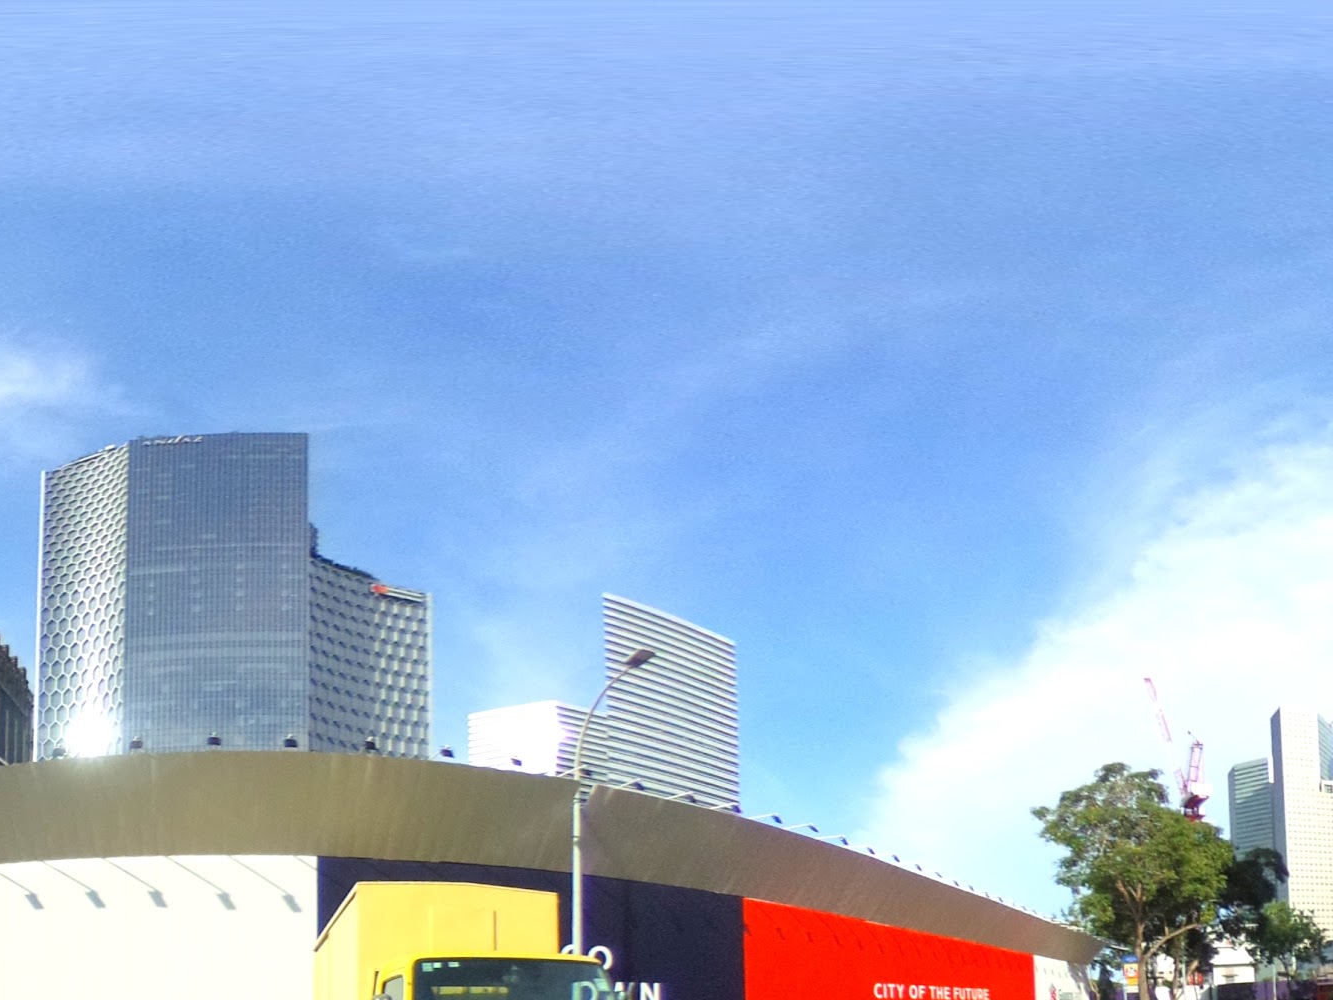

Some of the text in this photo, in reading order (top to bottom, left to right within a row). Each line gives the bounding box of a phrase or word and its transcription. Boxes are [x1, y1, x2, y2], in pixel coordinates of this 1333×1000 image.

[873, 983, 990, 1000] CITY OF THE FUTURE
